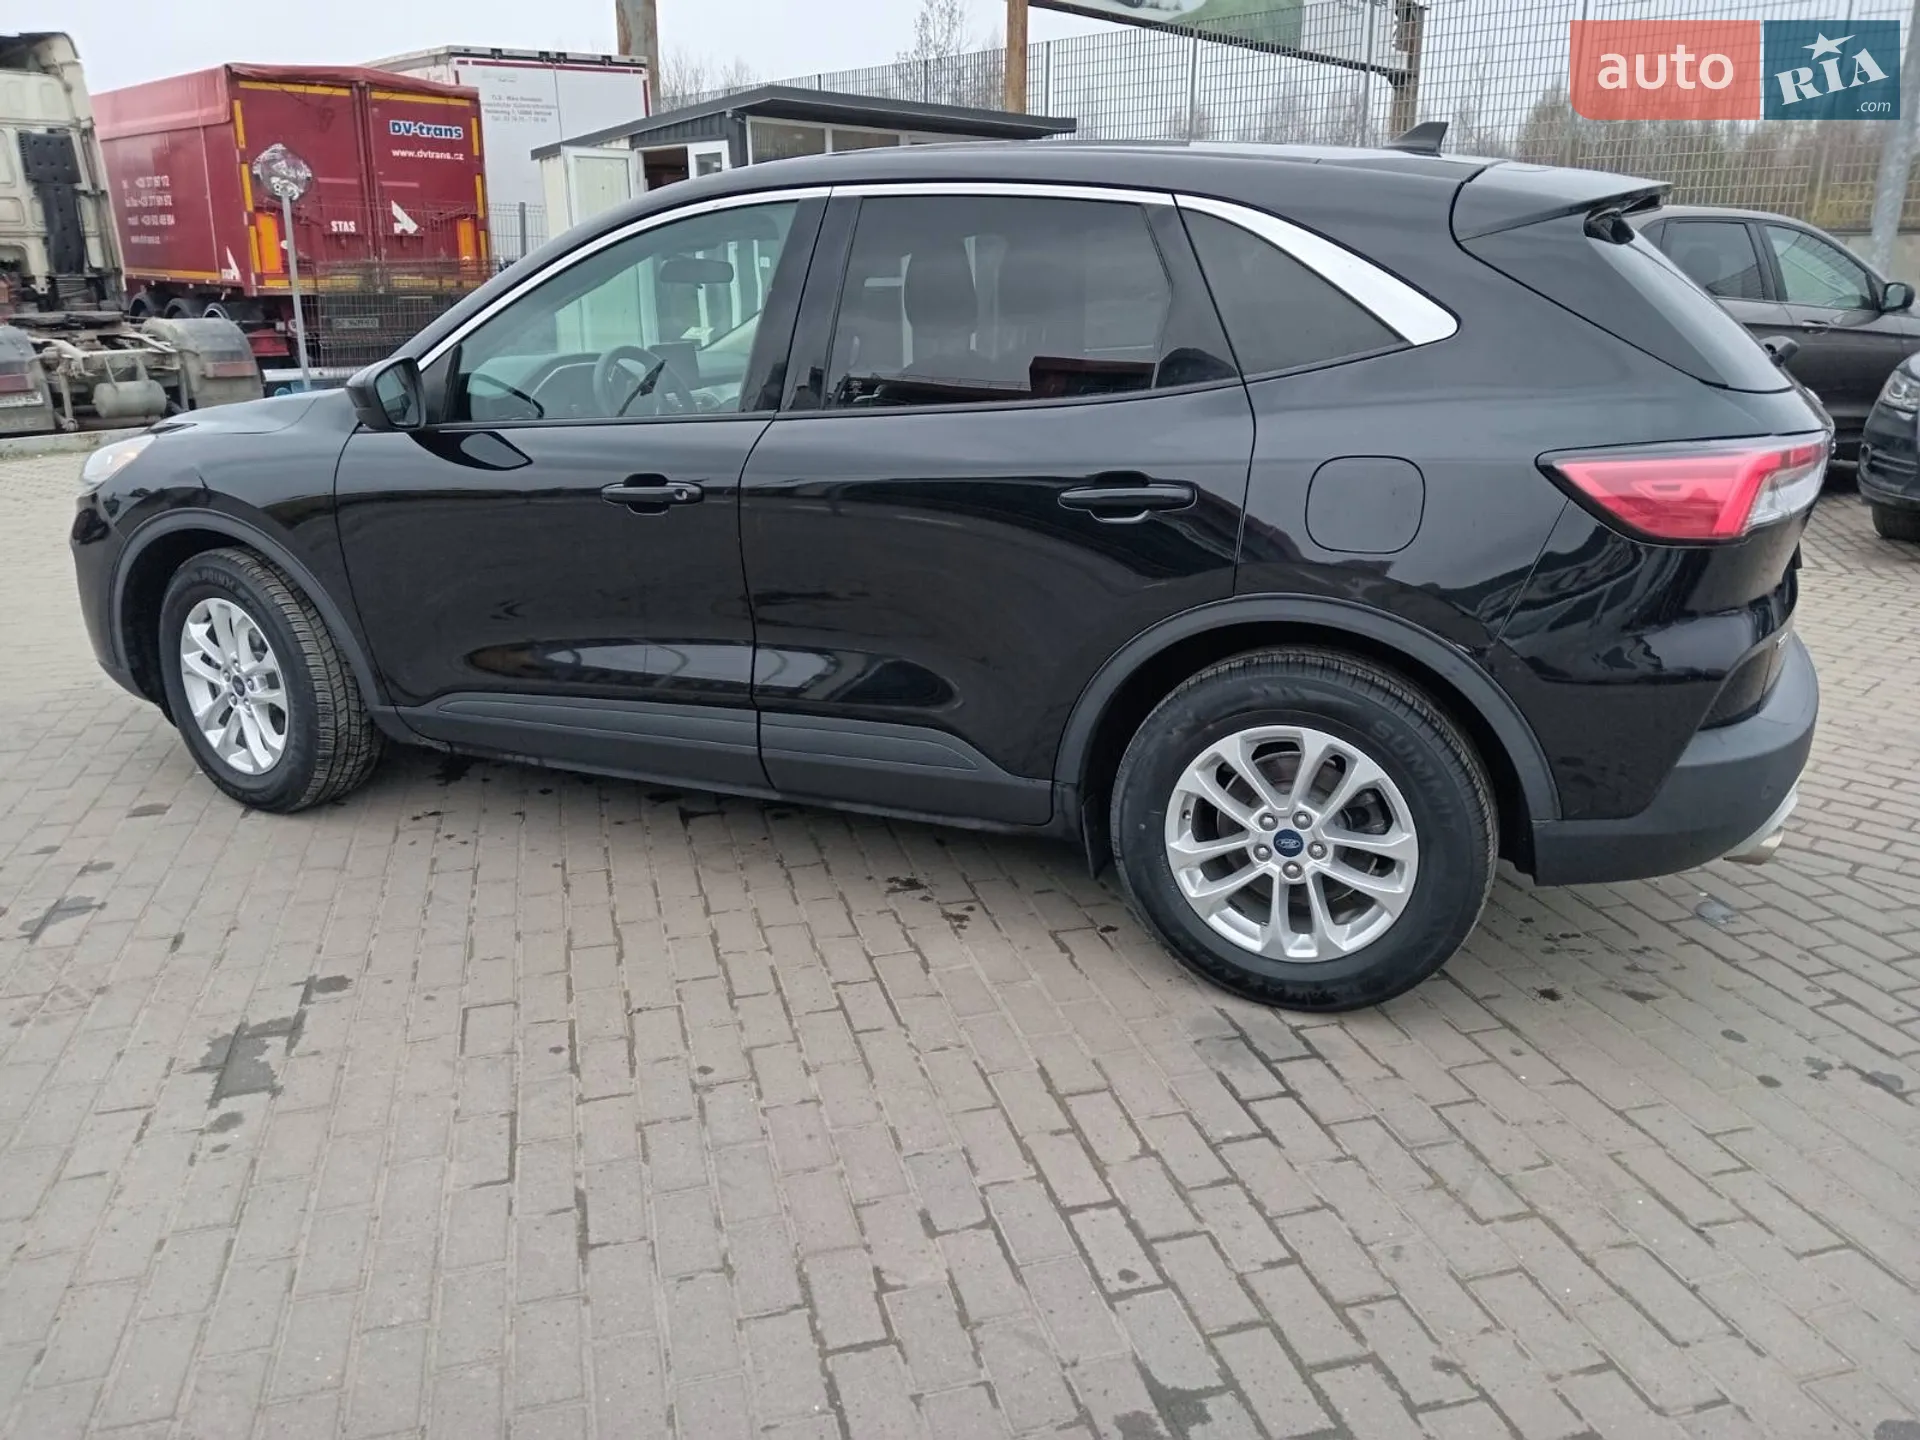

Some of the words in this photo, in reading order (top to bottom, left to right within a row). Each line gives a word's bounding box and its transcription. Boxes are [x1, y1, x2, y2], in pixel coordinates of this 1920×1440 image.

[390, 120, 464, 140] DV-trans
[391, 149, 465, 161] www.dvtrans.cz
[330, 220, 356, 233] STAS
